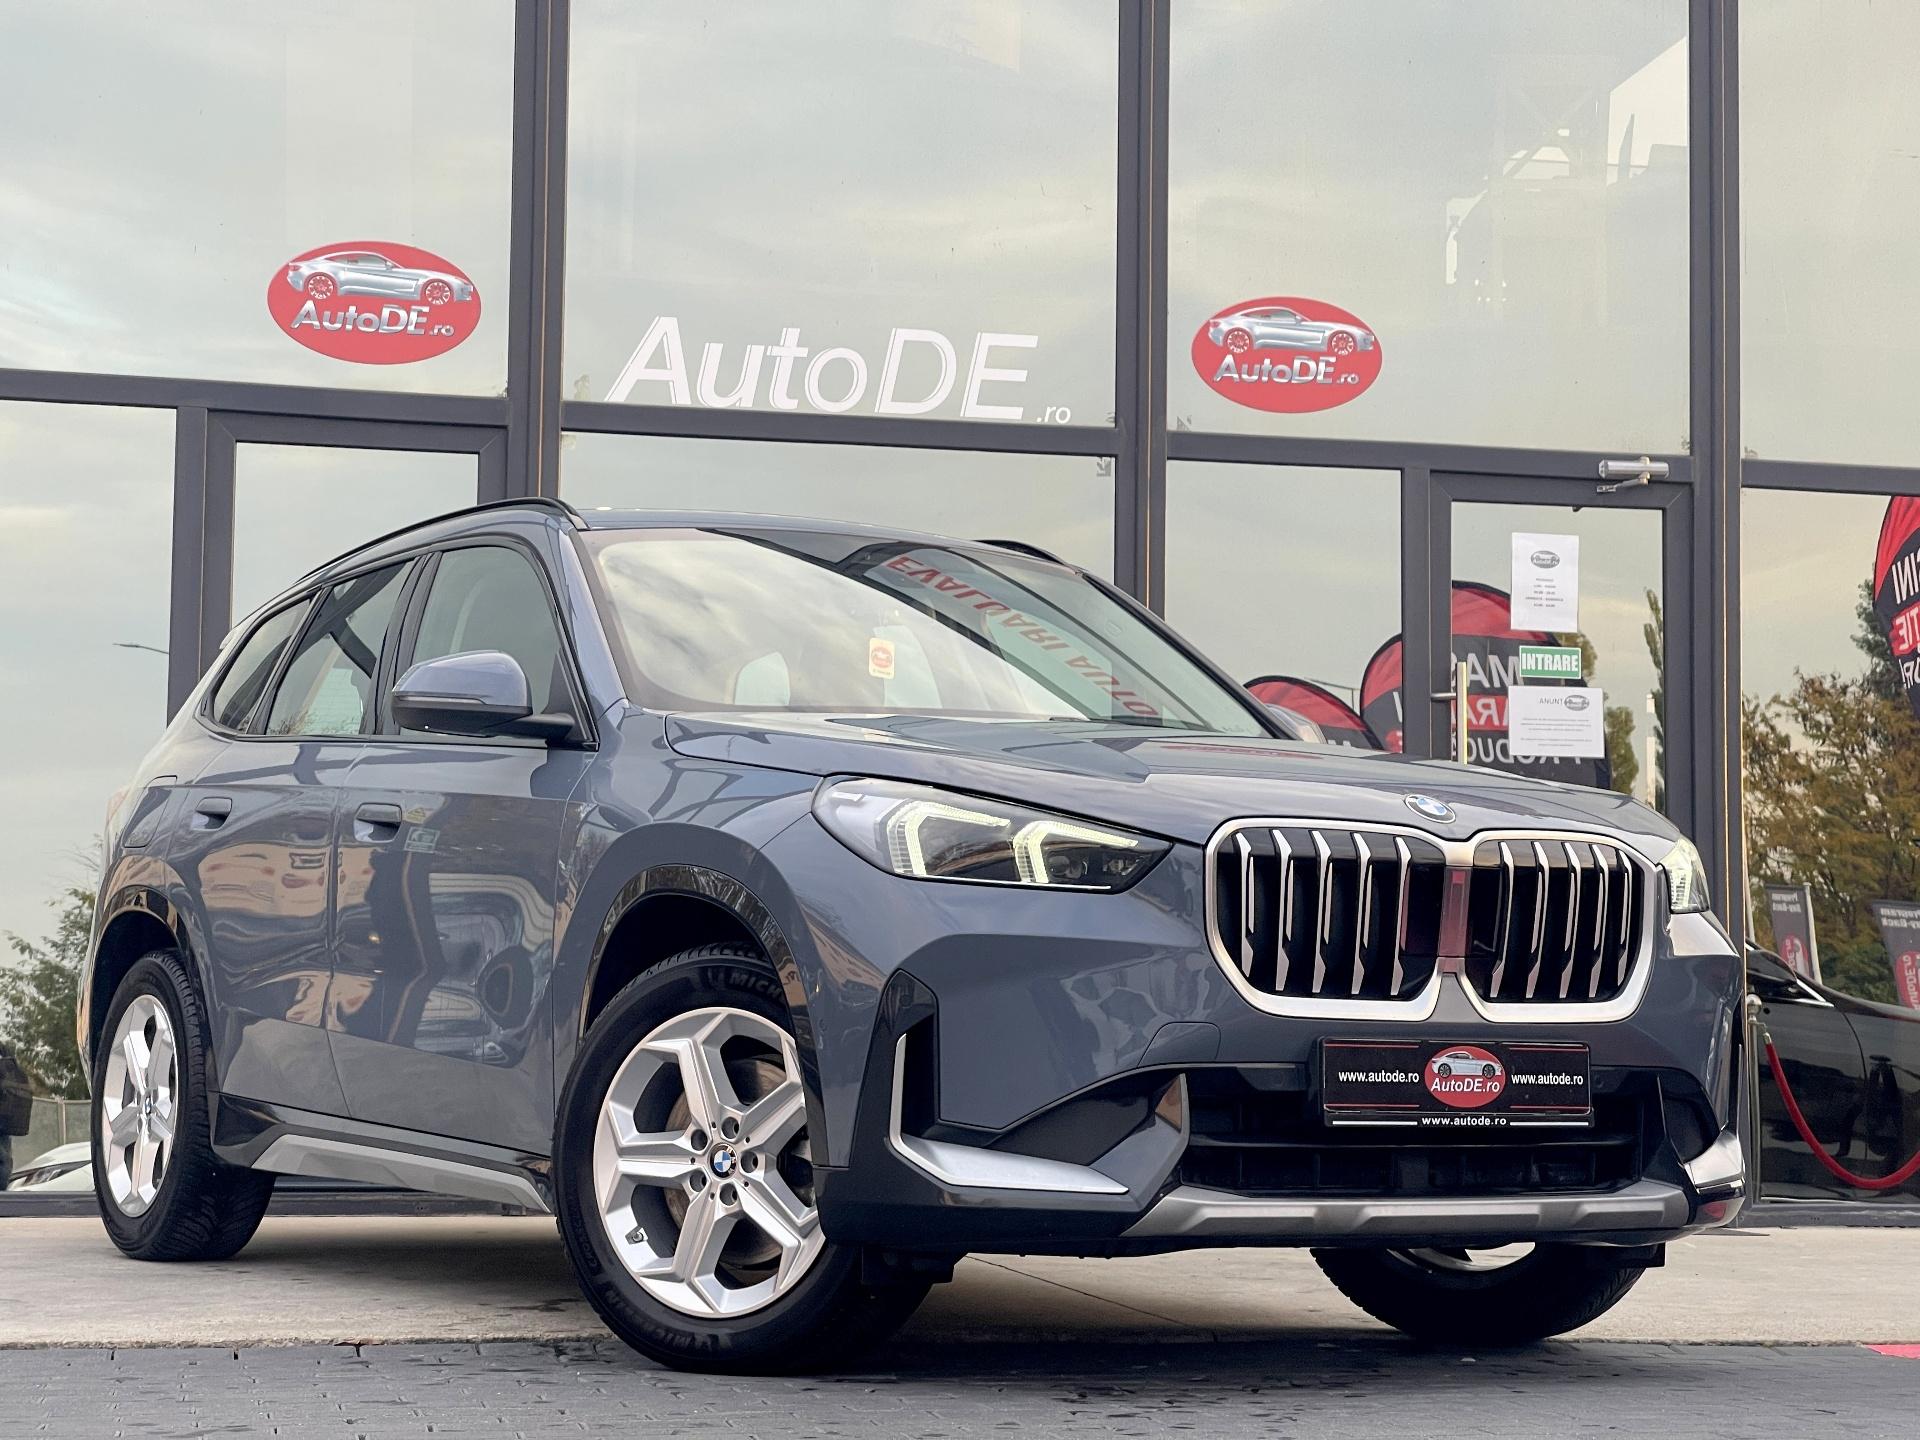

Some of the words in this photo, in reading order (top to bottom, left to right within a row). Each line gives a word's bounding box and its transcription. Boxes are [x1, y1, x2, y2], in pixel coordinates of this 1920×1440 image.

[1521, 652, 1579, 672] INTRARE
[1338, 1069, 1420, 1084] www.autode.ro
[1511, 1073, 1584, 1086] www.autode.ro
[1430, 1077, 1501, 1094] AutoDE.ro
[1421, 1116, 1507, 1126] www.autode.ro
